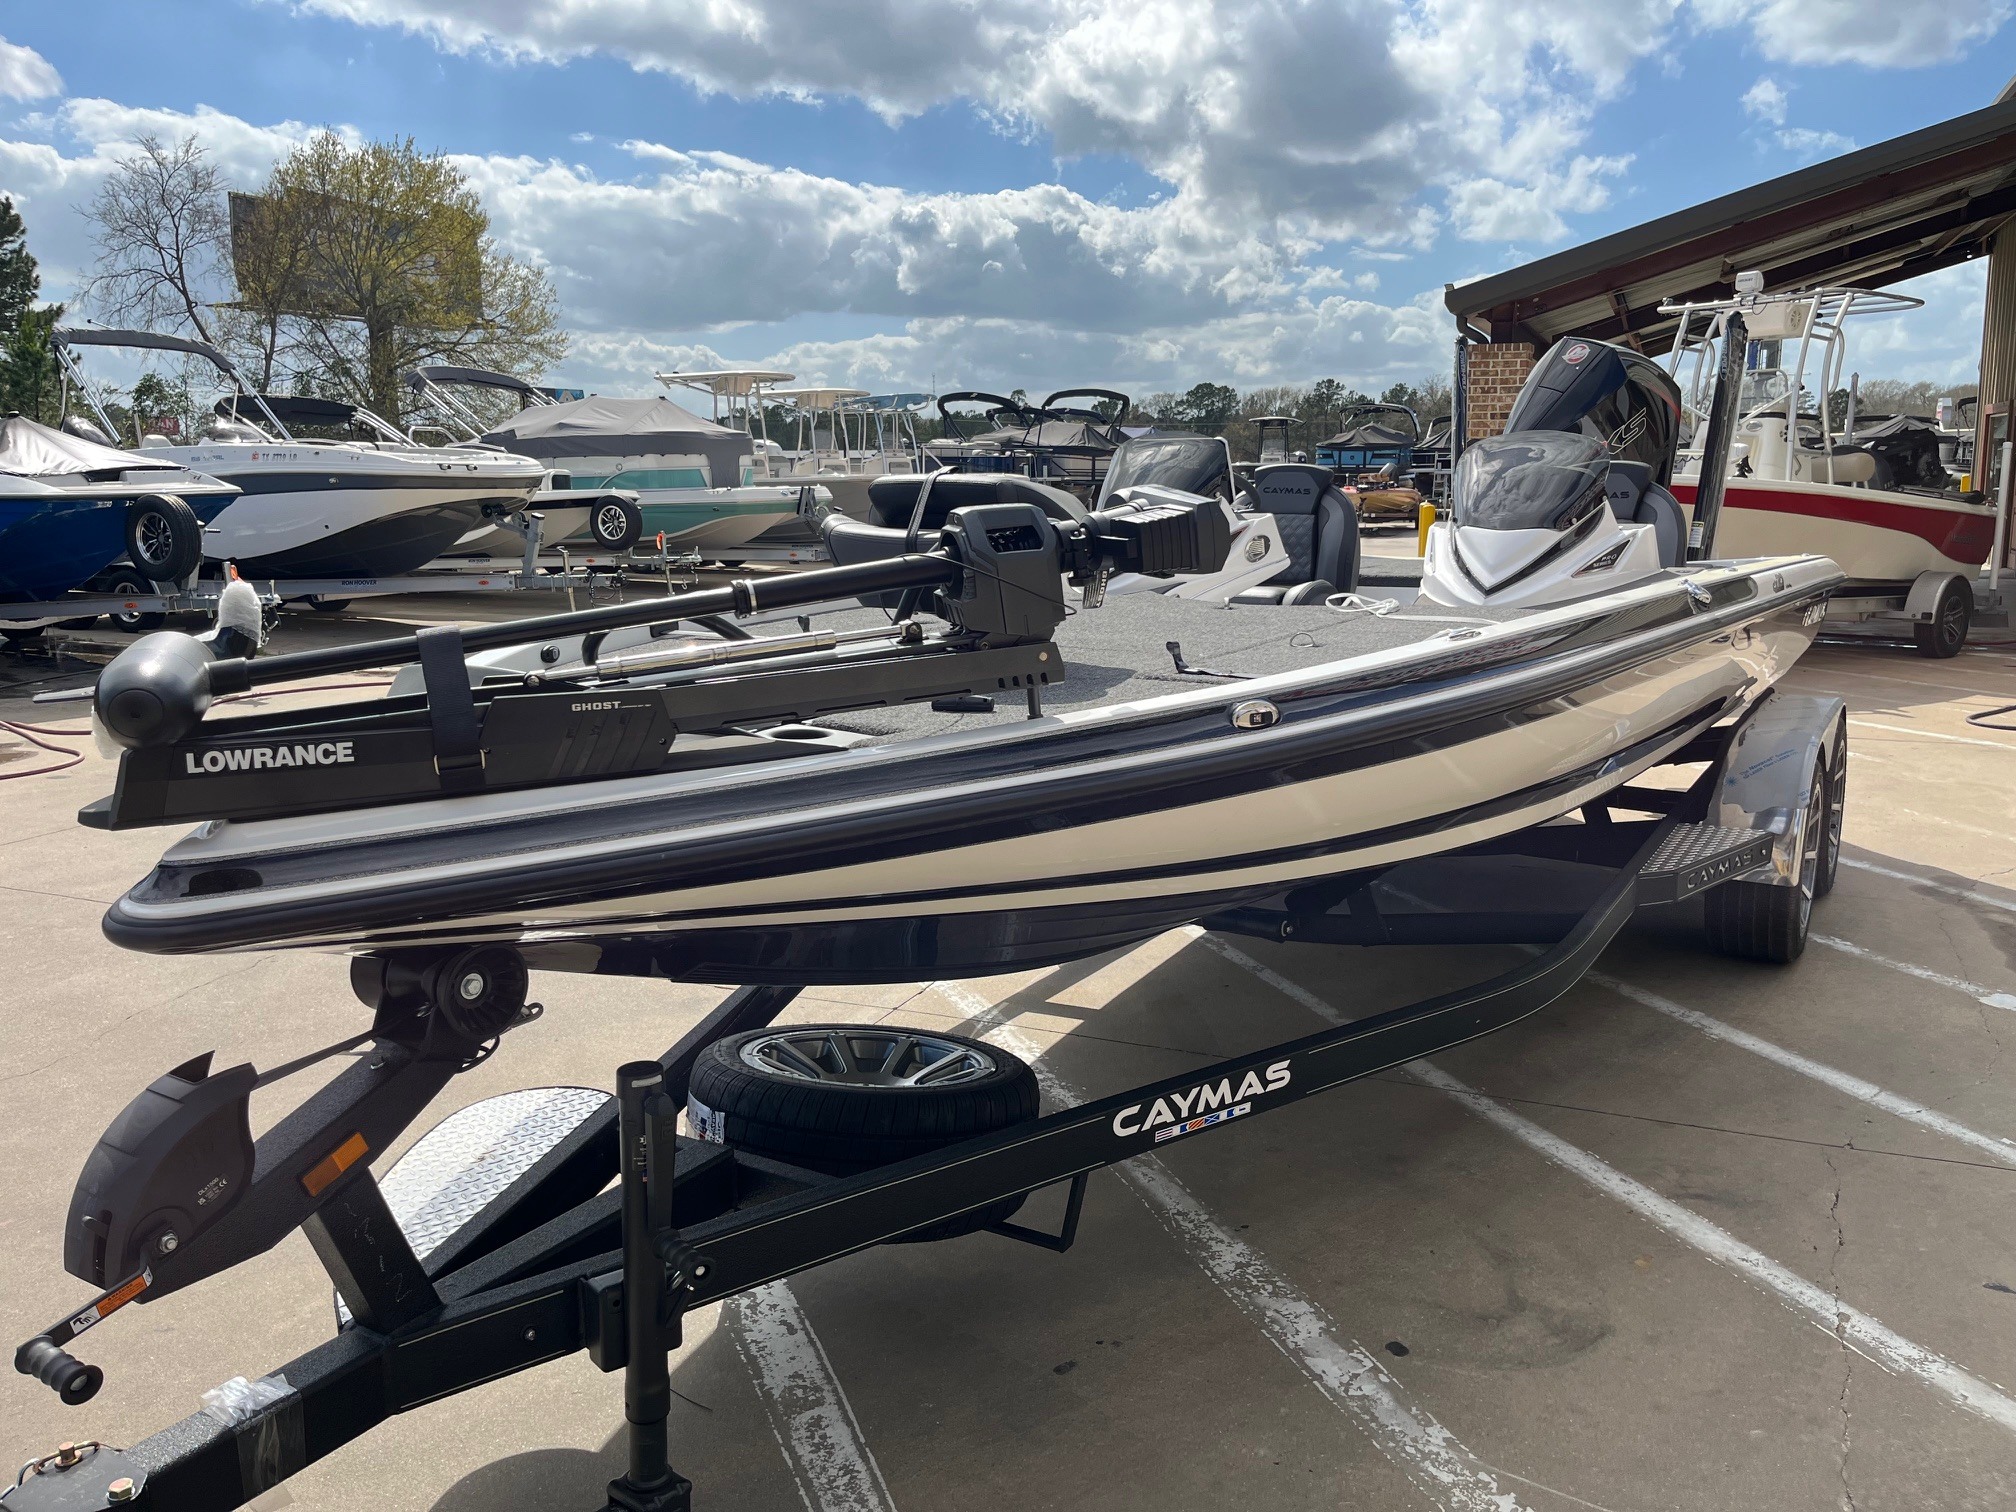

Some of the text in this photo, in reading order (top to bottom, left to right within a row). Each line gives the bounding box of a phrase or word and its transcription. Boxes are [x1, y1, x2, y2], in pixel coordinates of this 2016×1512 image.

[1263, 487, 1311, 495] CAYMAS
[571, 701, 622, 711] GHOST
[186, 742, 355, 774] LOWRANCE
[1687, 849, 1754, 889] CAYMAS
[1112, 1059, 1291, 1137] CAYMAS
